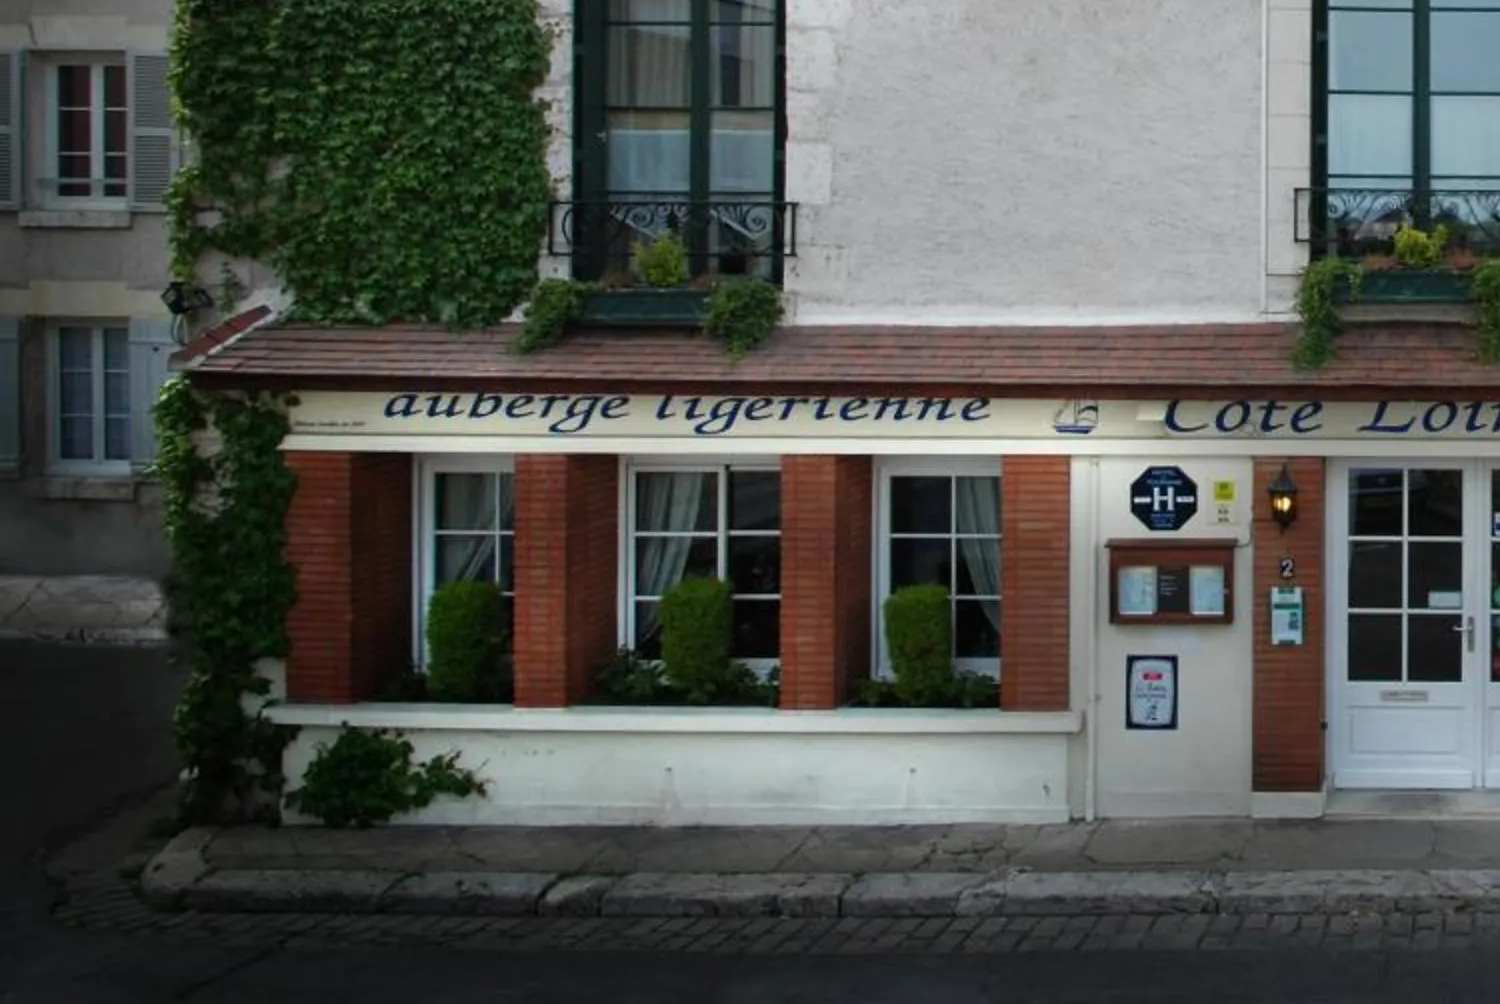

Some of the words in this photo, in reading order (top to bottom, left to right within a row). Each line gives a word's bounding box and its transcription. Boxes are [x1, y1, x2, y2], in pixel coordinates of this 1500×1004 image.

[384, 392, 631, 433] auberge
[1152, 486, 1175, 512] H
[1281, 558, 1294, 577] 2
